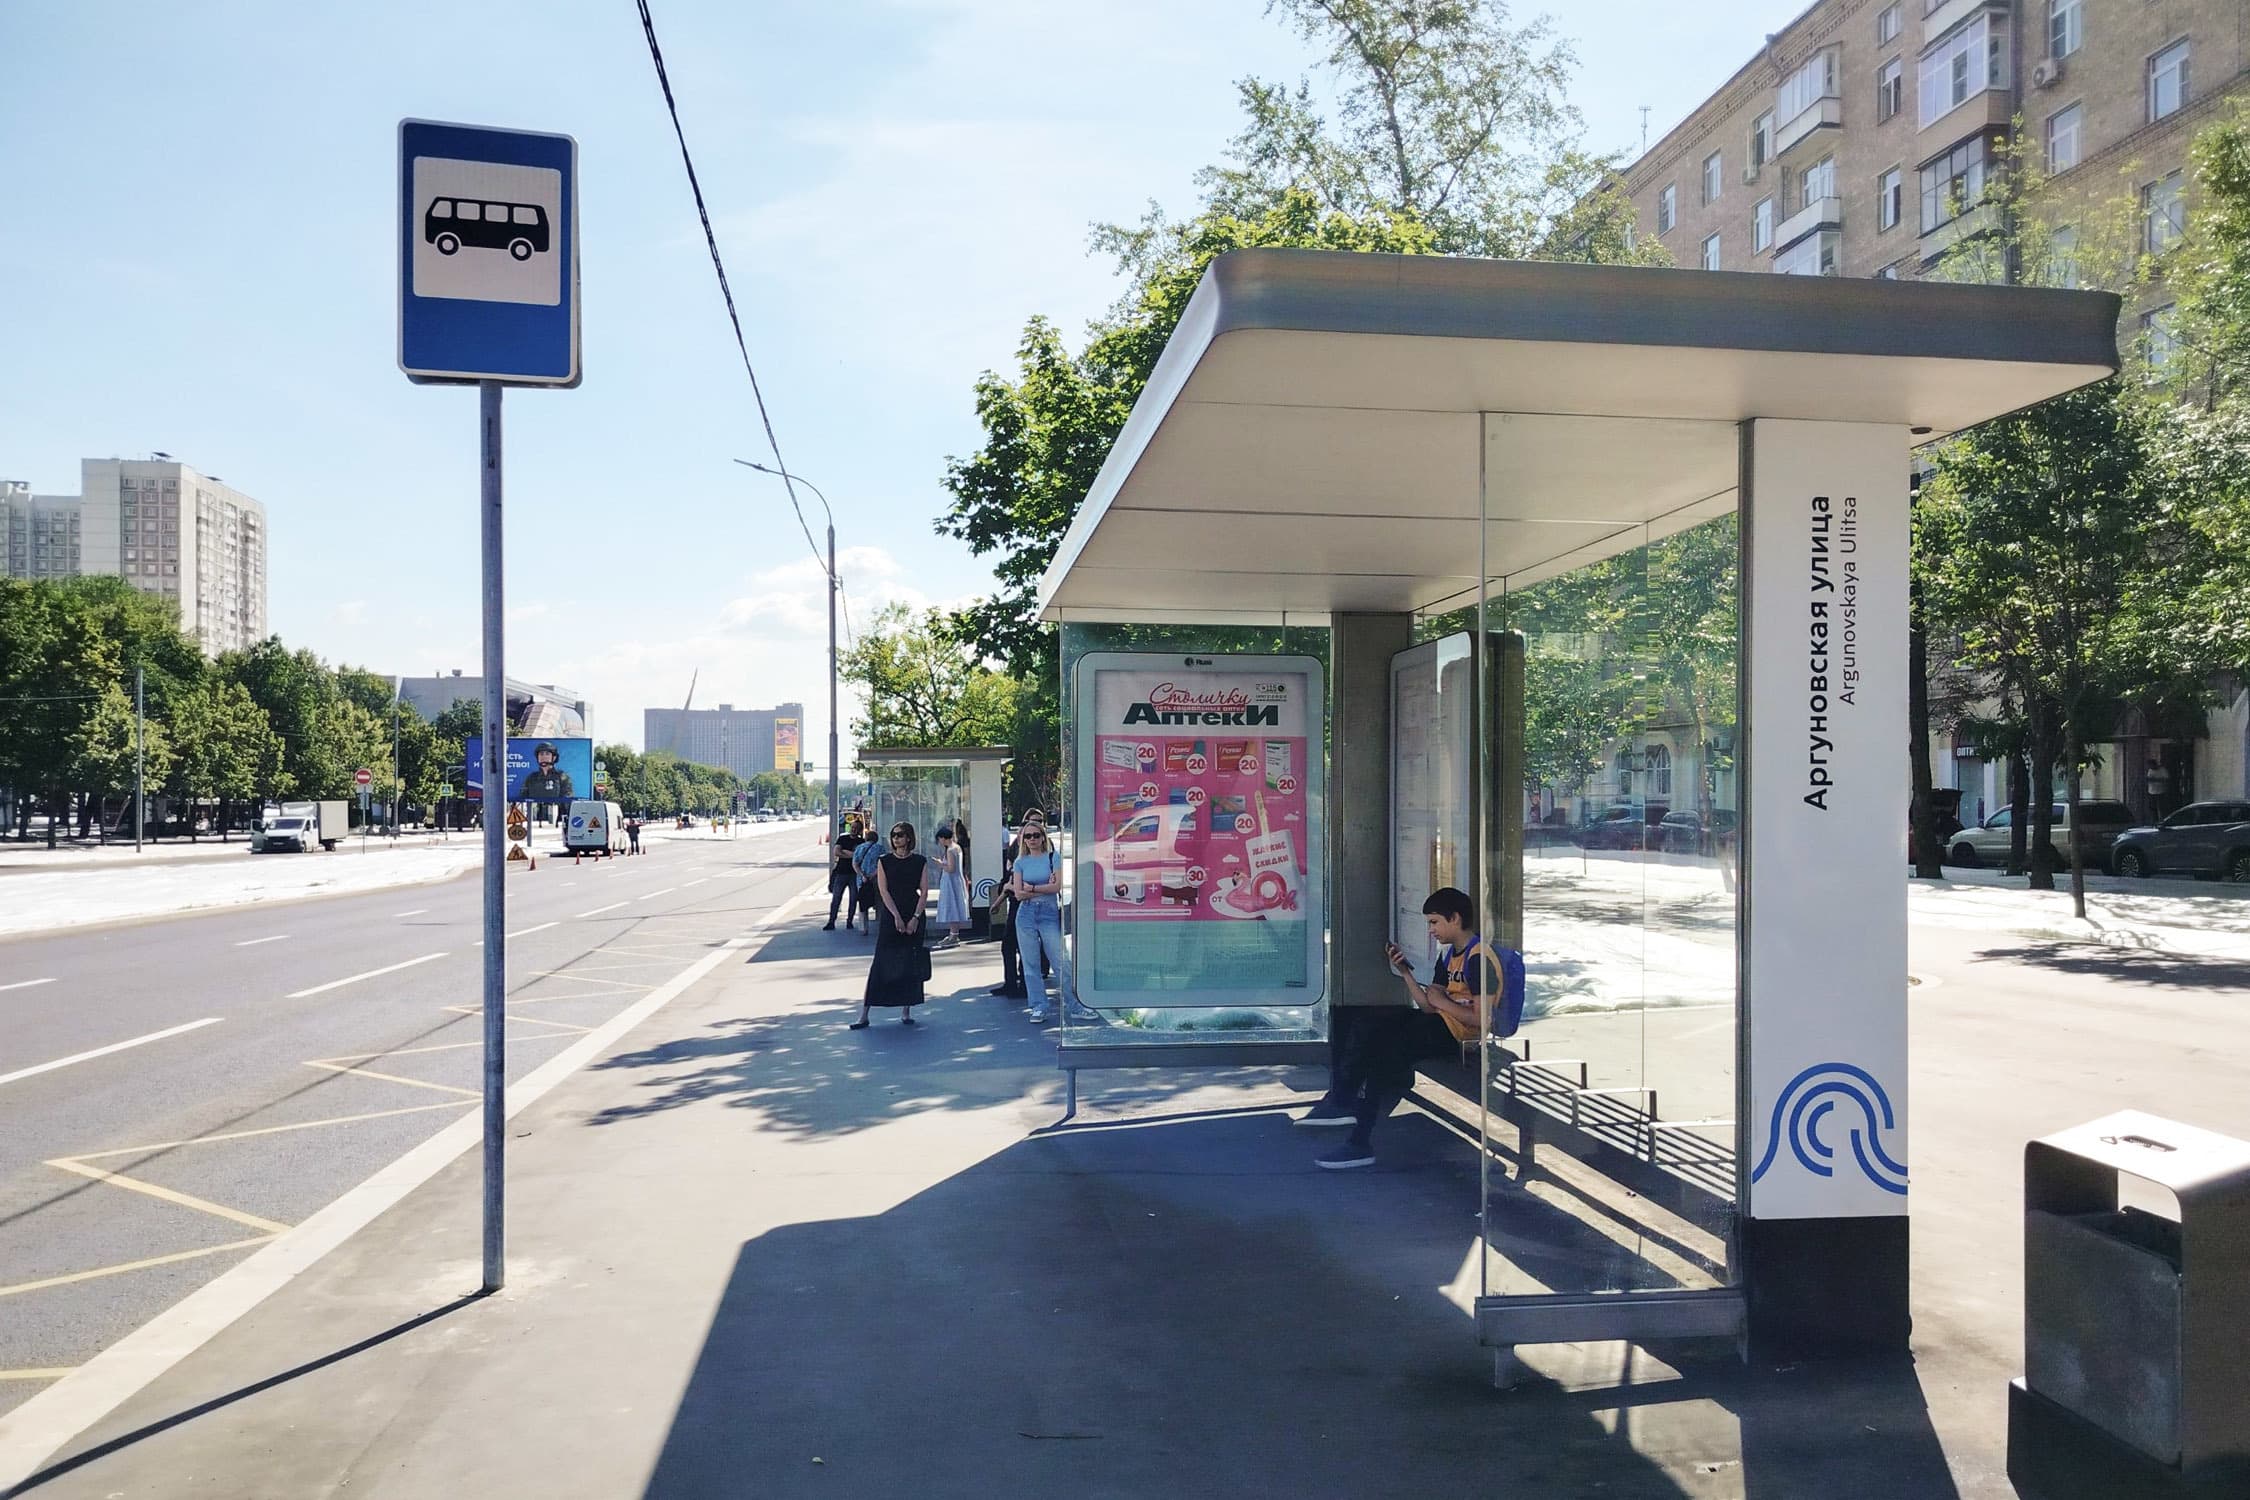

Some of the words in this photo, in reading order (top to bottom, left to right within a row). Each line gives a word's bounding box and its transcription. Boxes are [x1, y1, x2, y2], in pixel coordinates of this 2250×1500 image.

[1811, 495, 1834, 593] улица
[1839, 496, 1857, 554] Ulitsa
[1839, 561, 1860, 706] Argunovskaya
[1149, 682, 1252, 705] Столички
[1803, 601, 1833, 811] Аргуновская
